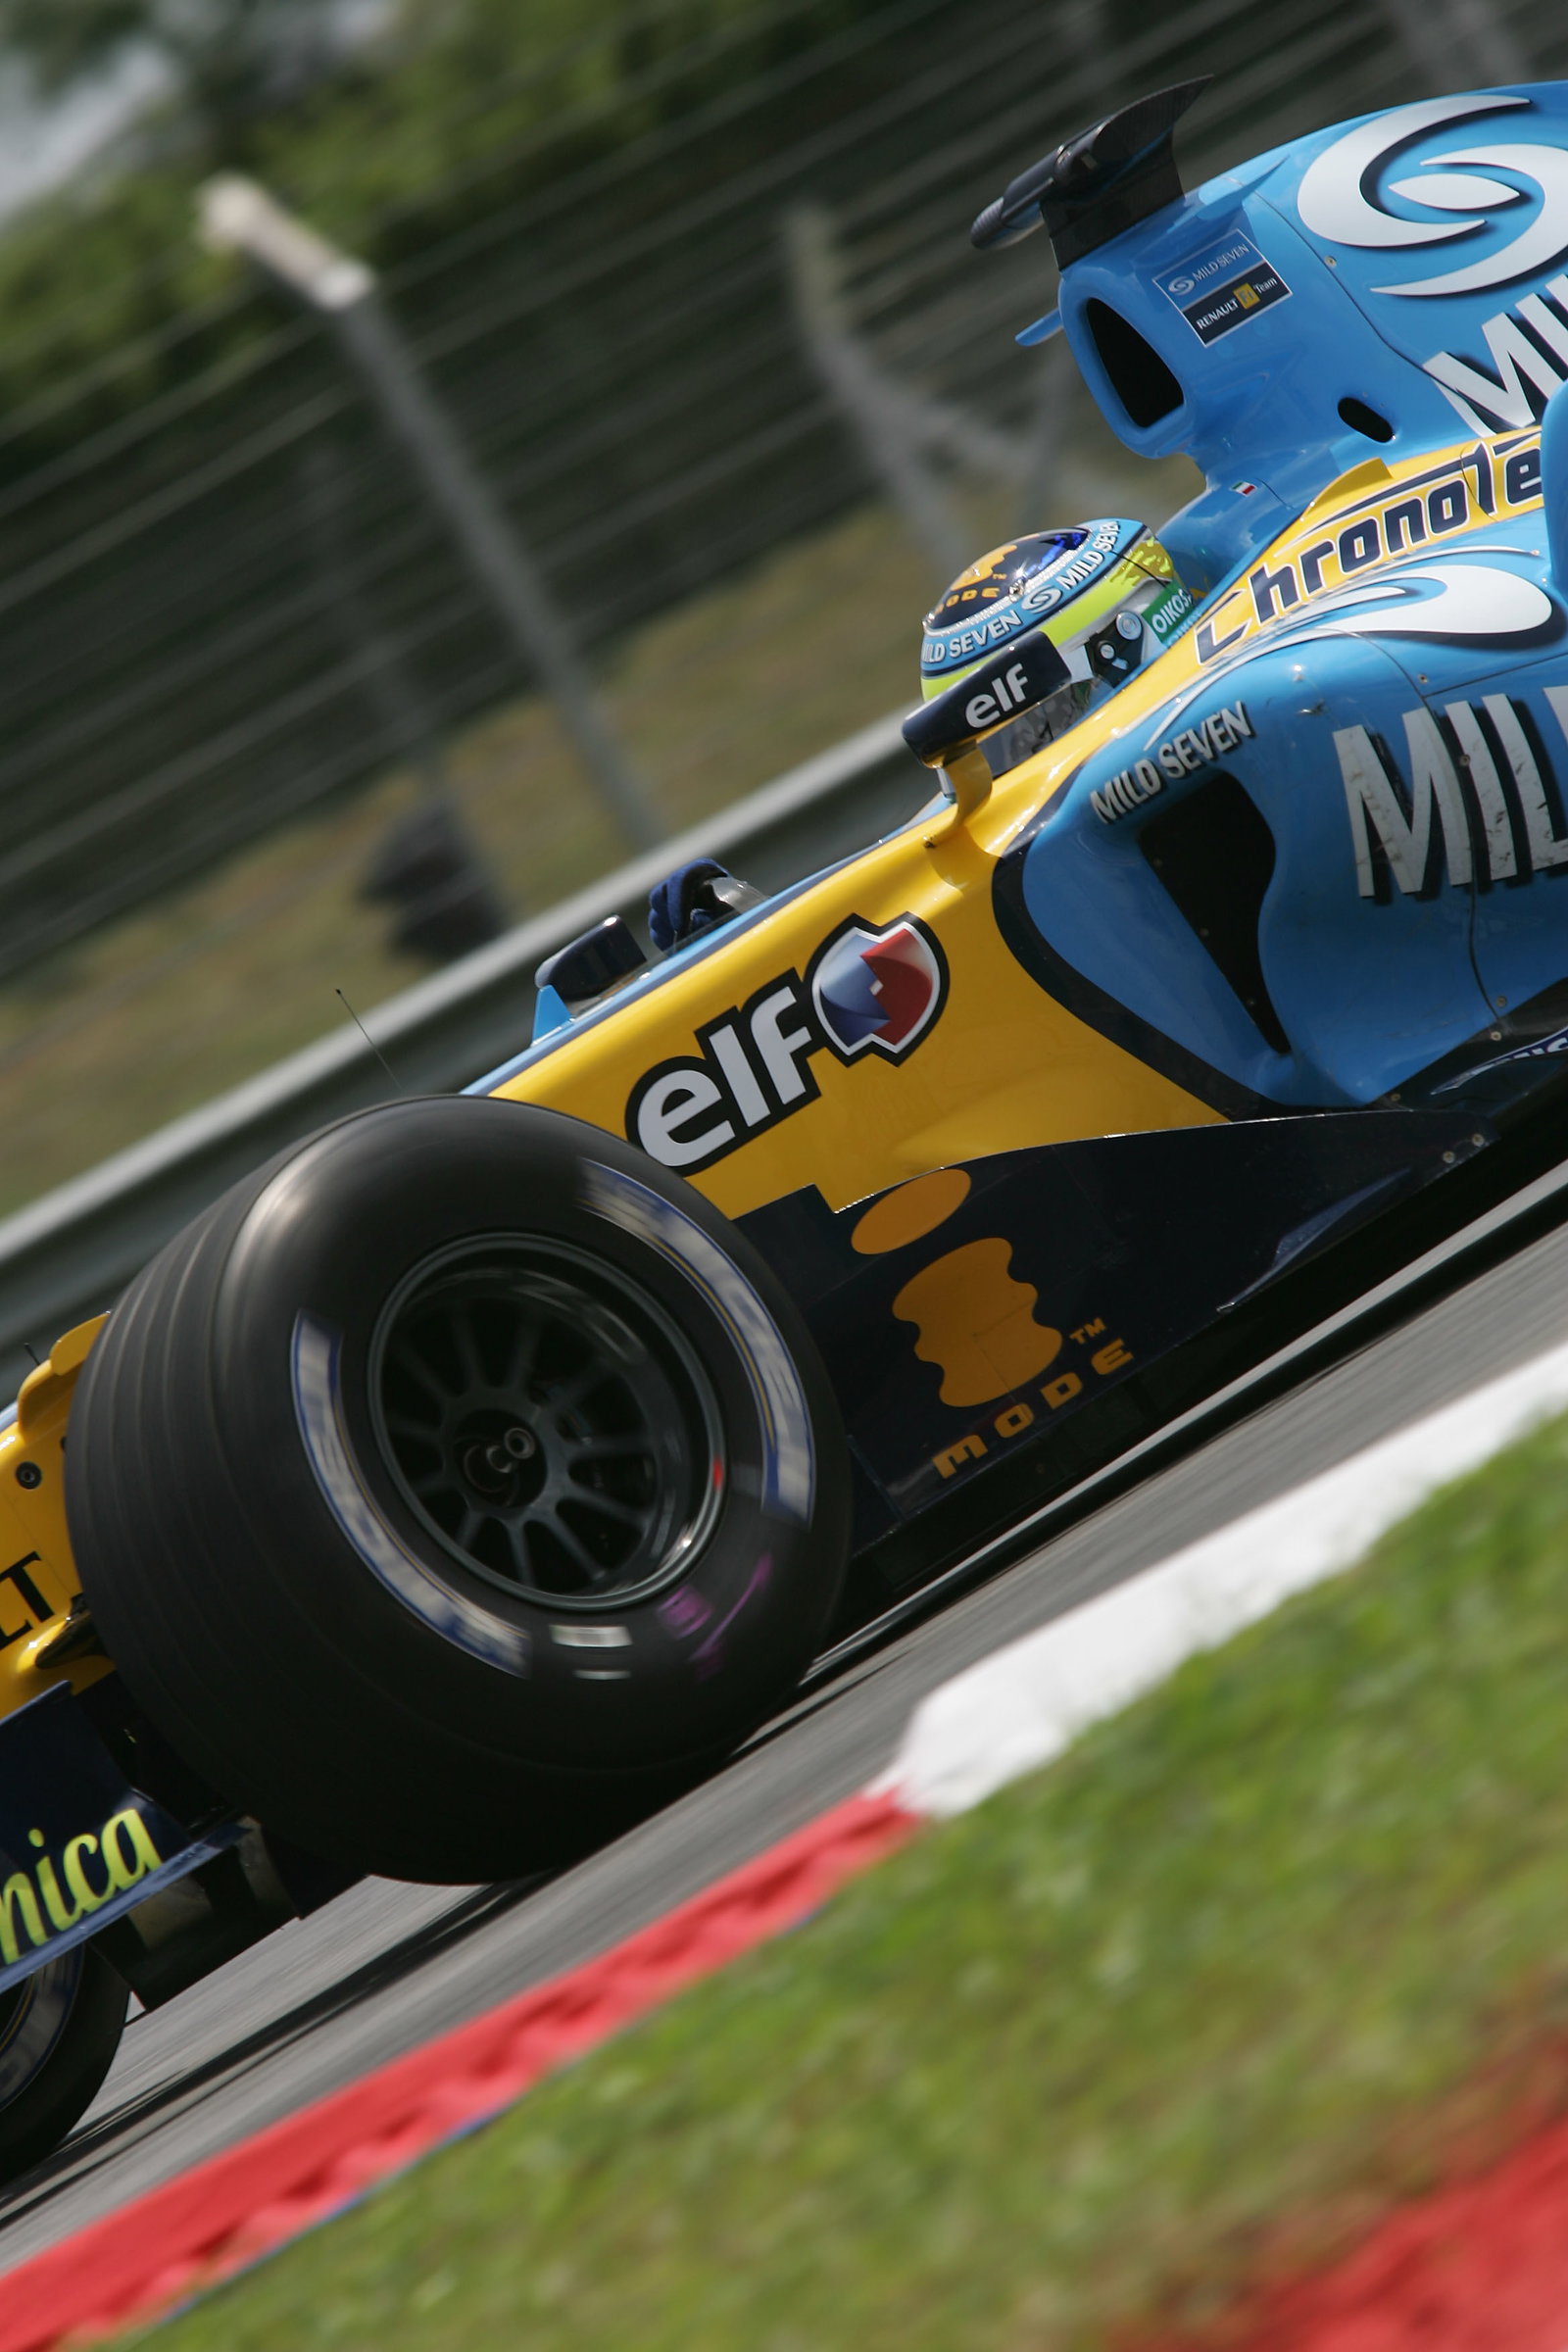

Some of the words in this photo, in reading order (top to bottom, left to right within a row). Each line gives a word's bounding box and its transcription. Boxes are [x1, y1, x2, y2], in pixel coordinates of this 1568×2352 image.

[1192, 261, 1219, 281] MILD
[1217, 244, 1250, 267] SEVEN
[1196, 298, 1240, 330] RENAULT
[1253, 277, 1278, 295] Team
[1423, 273, 1568, 438] MI
[1055, 550, 1104, 591] MILD
[1092, 520, 1120, 554] SEVE
[950, 610, 1022, 658] SEVEN
[965, 663, 1029, 728] elf
[1090, 759, 1162, 825] MILD
[1158, 701, 1252, 779] SEVEN
[637, 986, 811, 1167] elf
